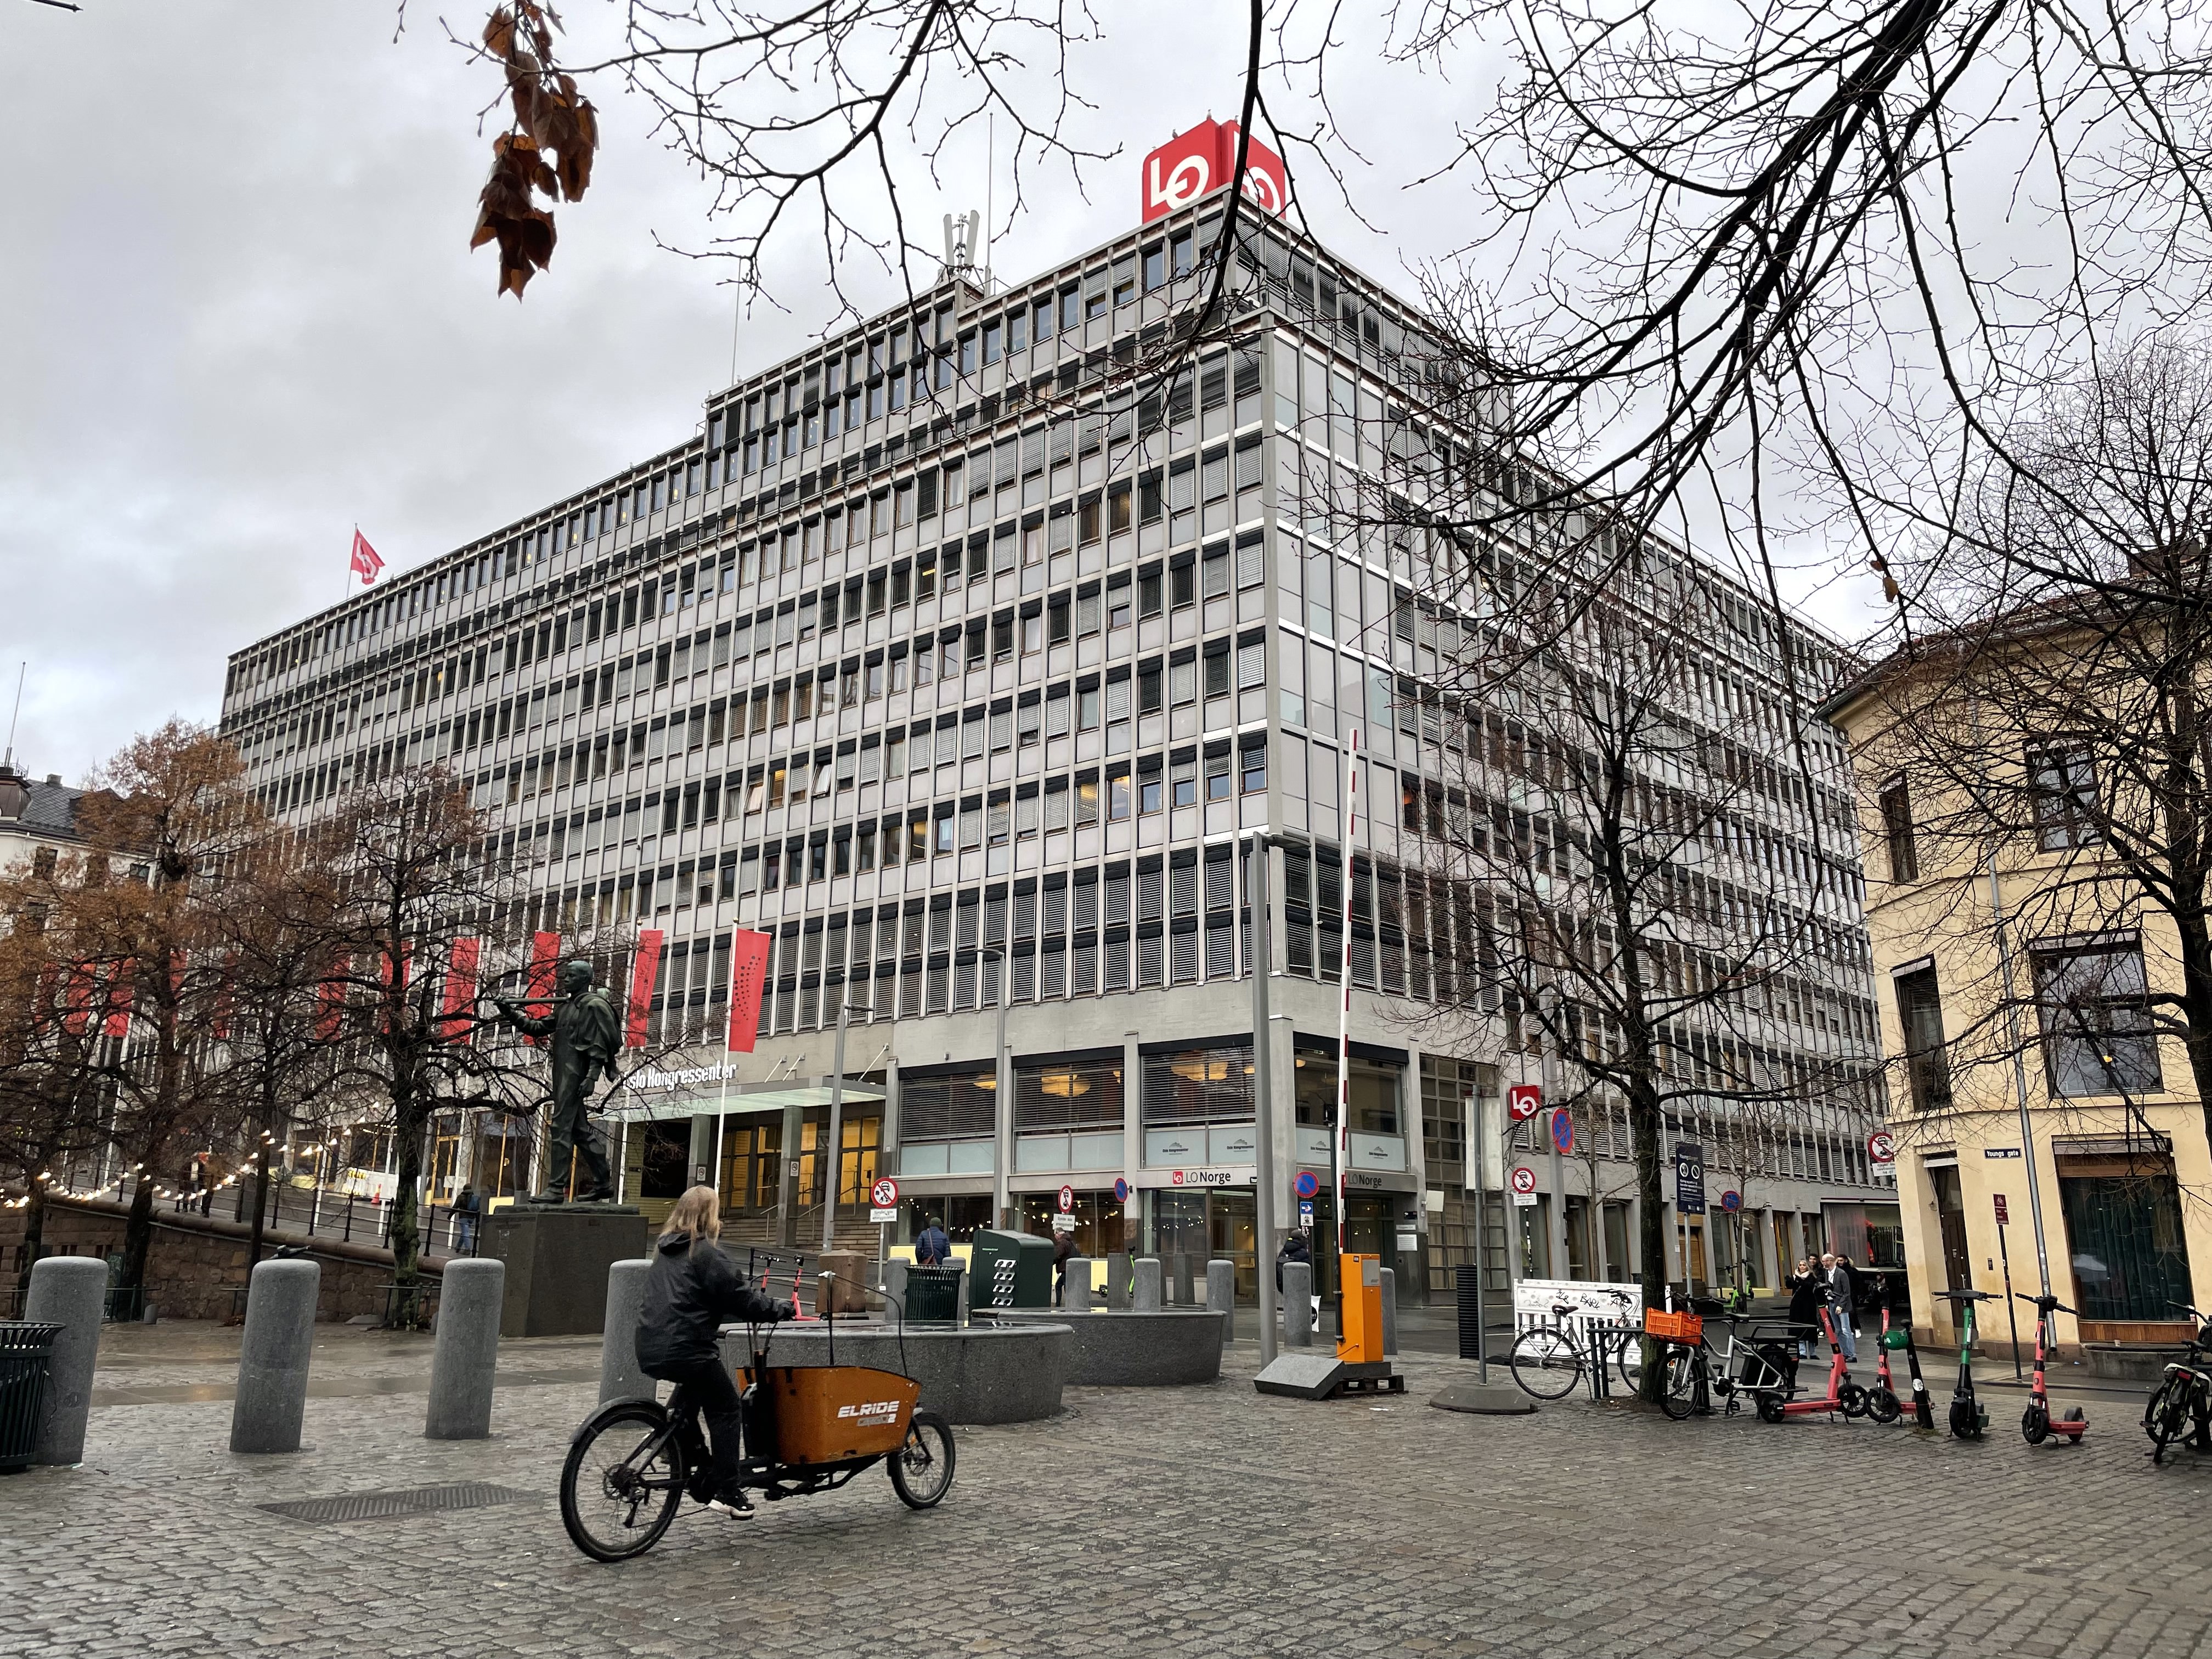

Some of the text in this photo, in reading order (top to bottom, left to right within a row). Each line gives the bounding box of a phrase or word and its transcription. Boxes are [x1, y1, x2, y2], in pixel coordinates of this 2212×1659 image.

[1150, 155, 1209, 210] LO
[647, 1060, 737, 1091] Kongressenter
[1512, 1090, 1537, 1116] LO
[1186, 1171, 1231, 1185] LO Norge
[1348, 1173, 1382, 1189] LO Norge
[837, 1400, 900, 1418] ELRIDE
